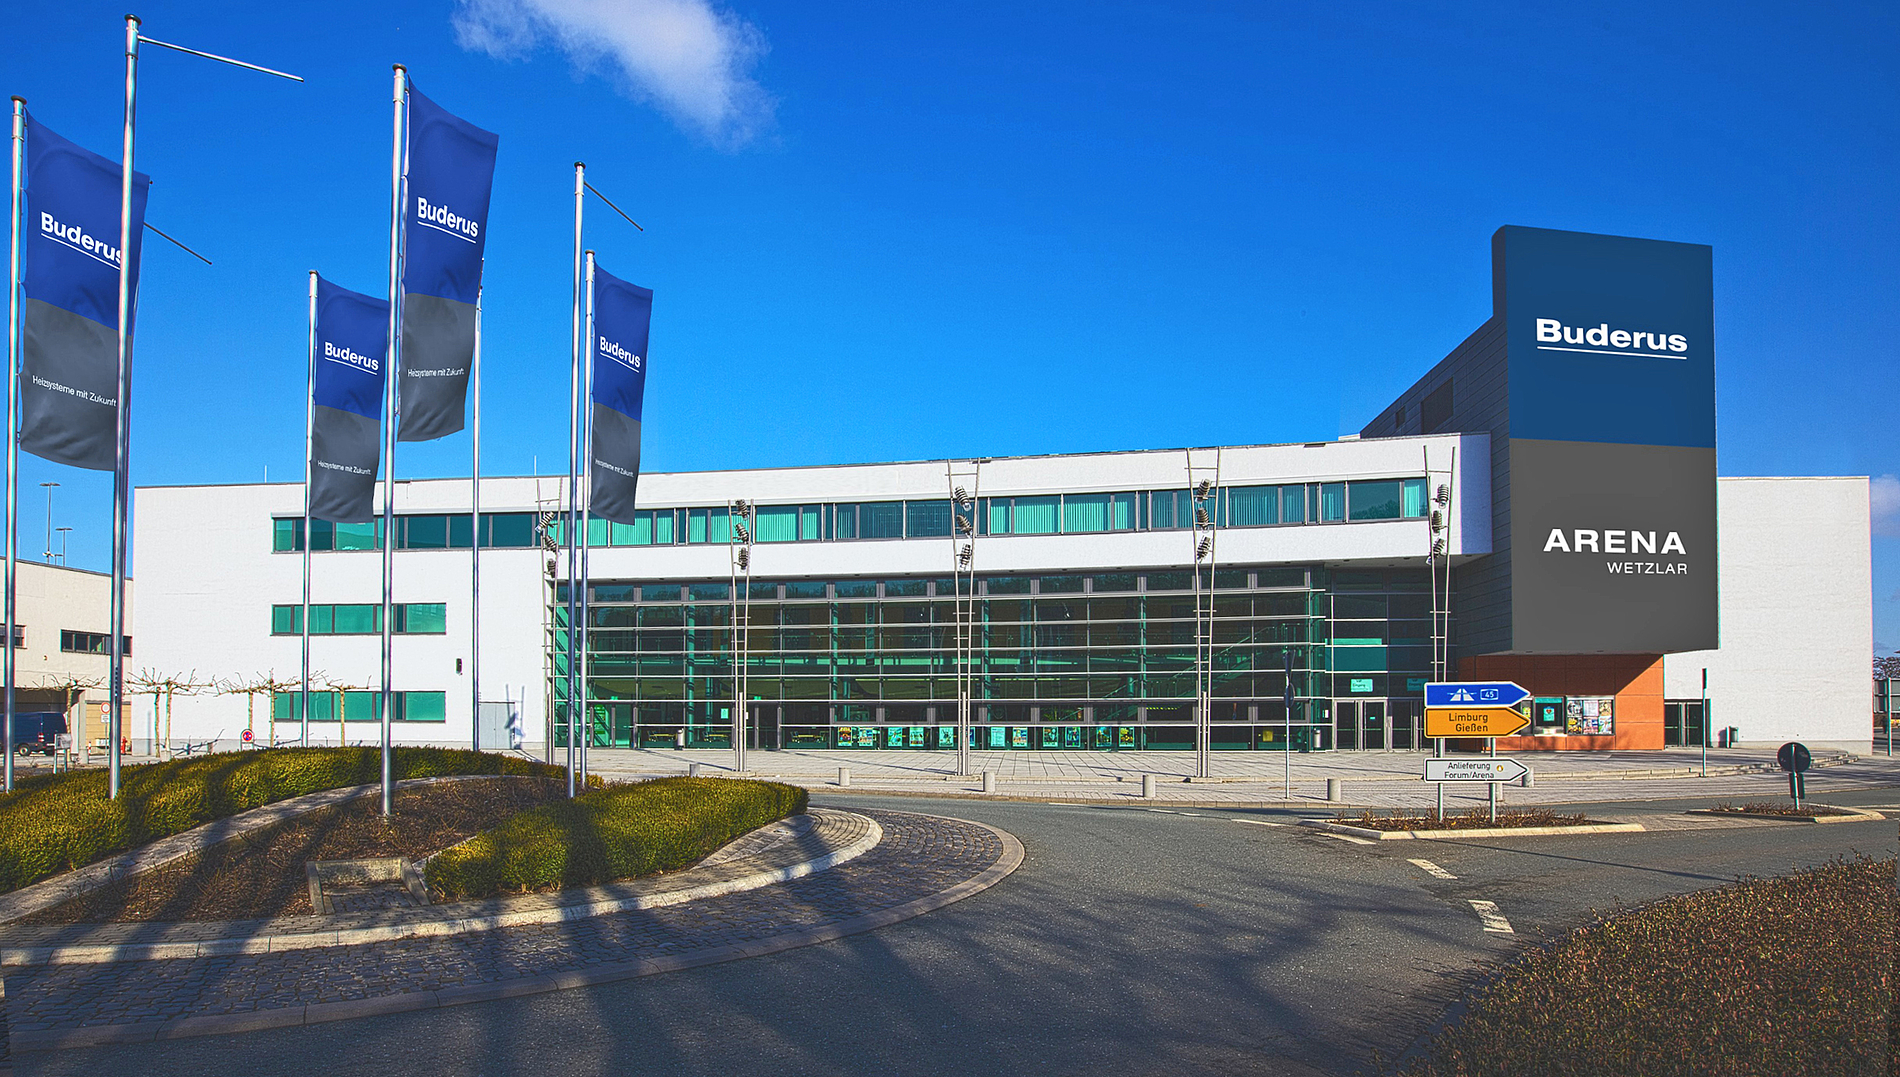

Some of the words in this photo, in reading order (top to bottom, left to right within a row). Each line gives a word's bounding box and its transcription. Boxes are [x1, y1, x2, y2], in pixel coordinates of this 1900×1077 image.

[417, 196, 479, 237] Buderus
[1536, 318, 1688, 352] Buderus
[325, 341, 379, 370] Buderus
[600, 335, 641, 368] Buderus
[32, 375, 75, 395] Heizsysteme
[76, 389, 88, 400] mit
[1543, 528, 1687, 555] ARENA
[1606, 561, 1688, 575] WETZLAR
[1448, 712, 1488, 723] Limburg
[1455, 723, 1488, 732] Gießen
[1444, 771, 1494, 779] Forum/Arena
[1447, 762, 1491, 771] Anlieferung
